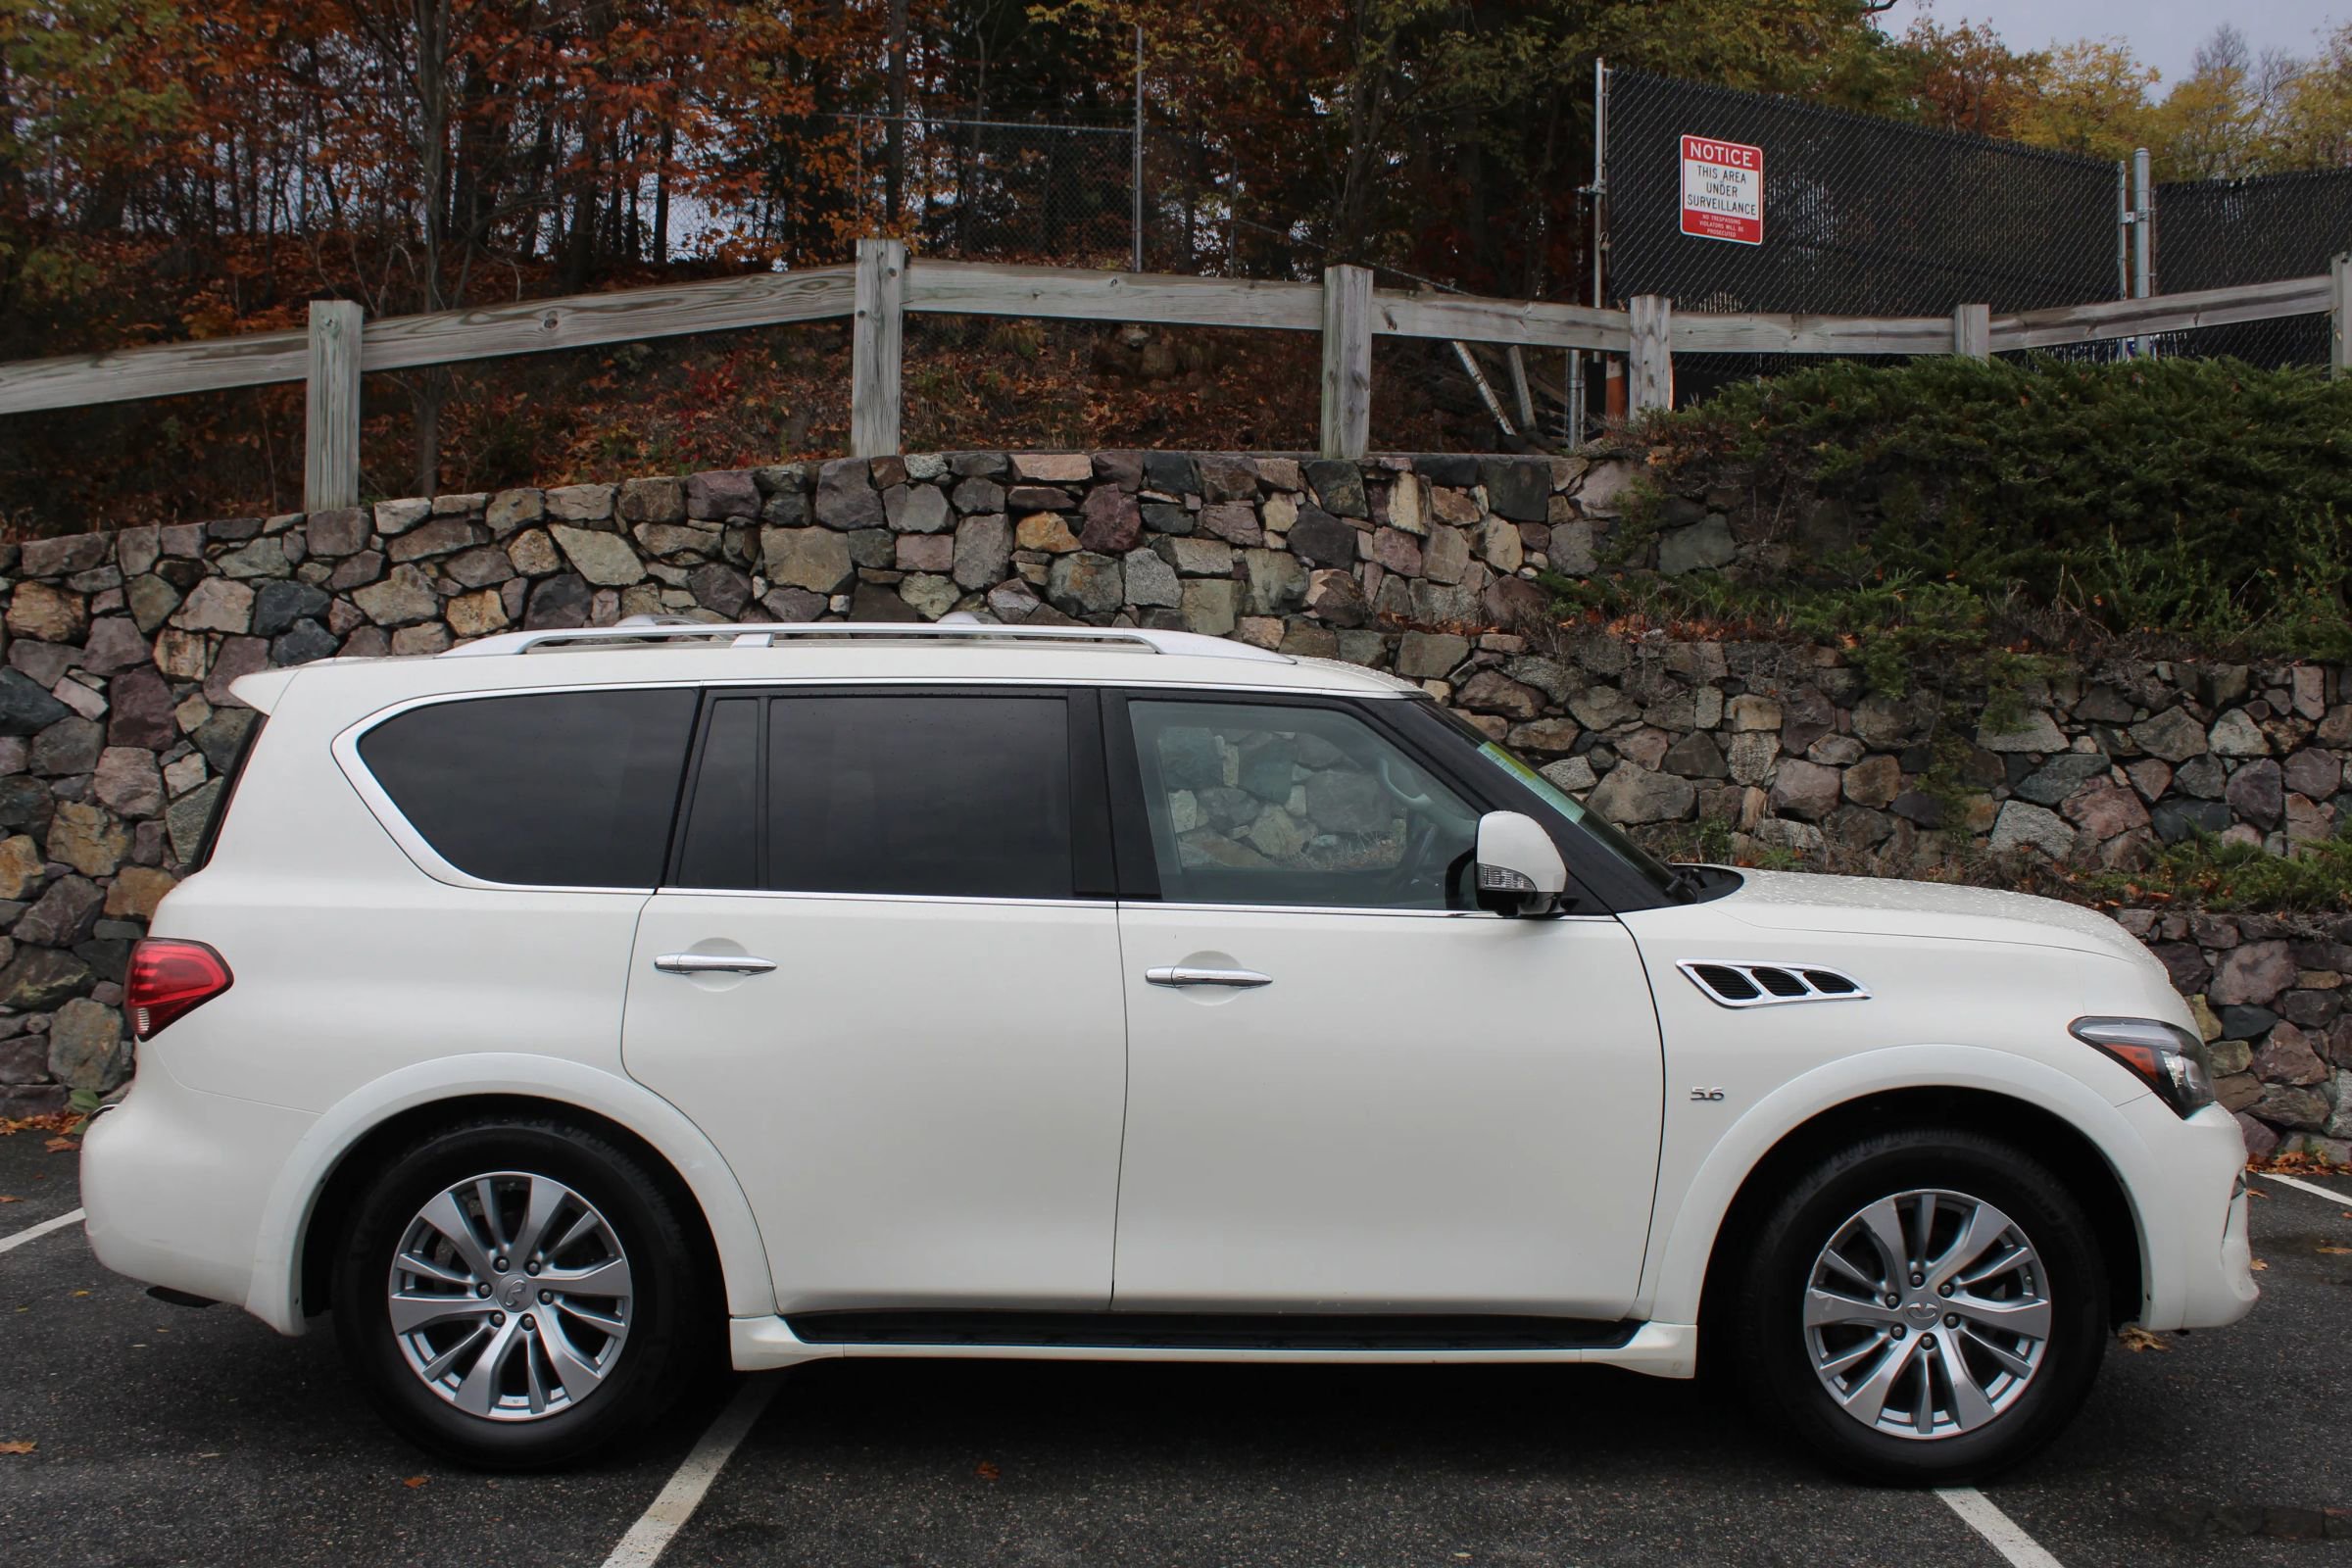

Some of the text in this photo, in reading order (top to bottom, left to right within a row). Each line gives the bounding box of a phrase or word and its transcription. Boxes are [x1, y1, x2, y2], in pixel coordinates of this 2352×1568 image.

[1690, 141, 1753, 168] NOTICE
[1697, 166, 1746, 184] THIS AREA
[1706, 182, 1738, 198] UNDER
[1688, 194, 1756, 216] SURVEILLANCE
[1699, 220, 1725, 229] VIOLATORS
[1711, 215, 1740, 224] TRESPASSING
[1706, 228, 1737, 237] PROSECUTED
